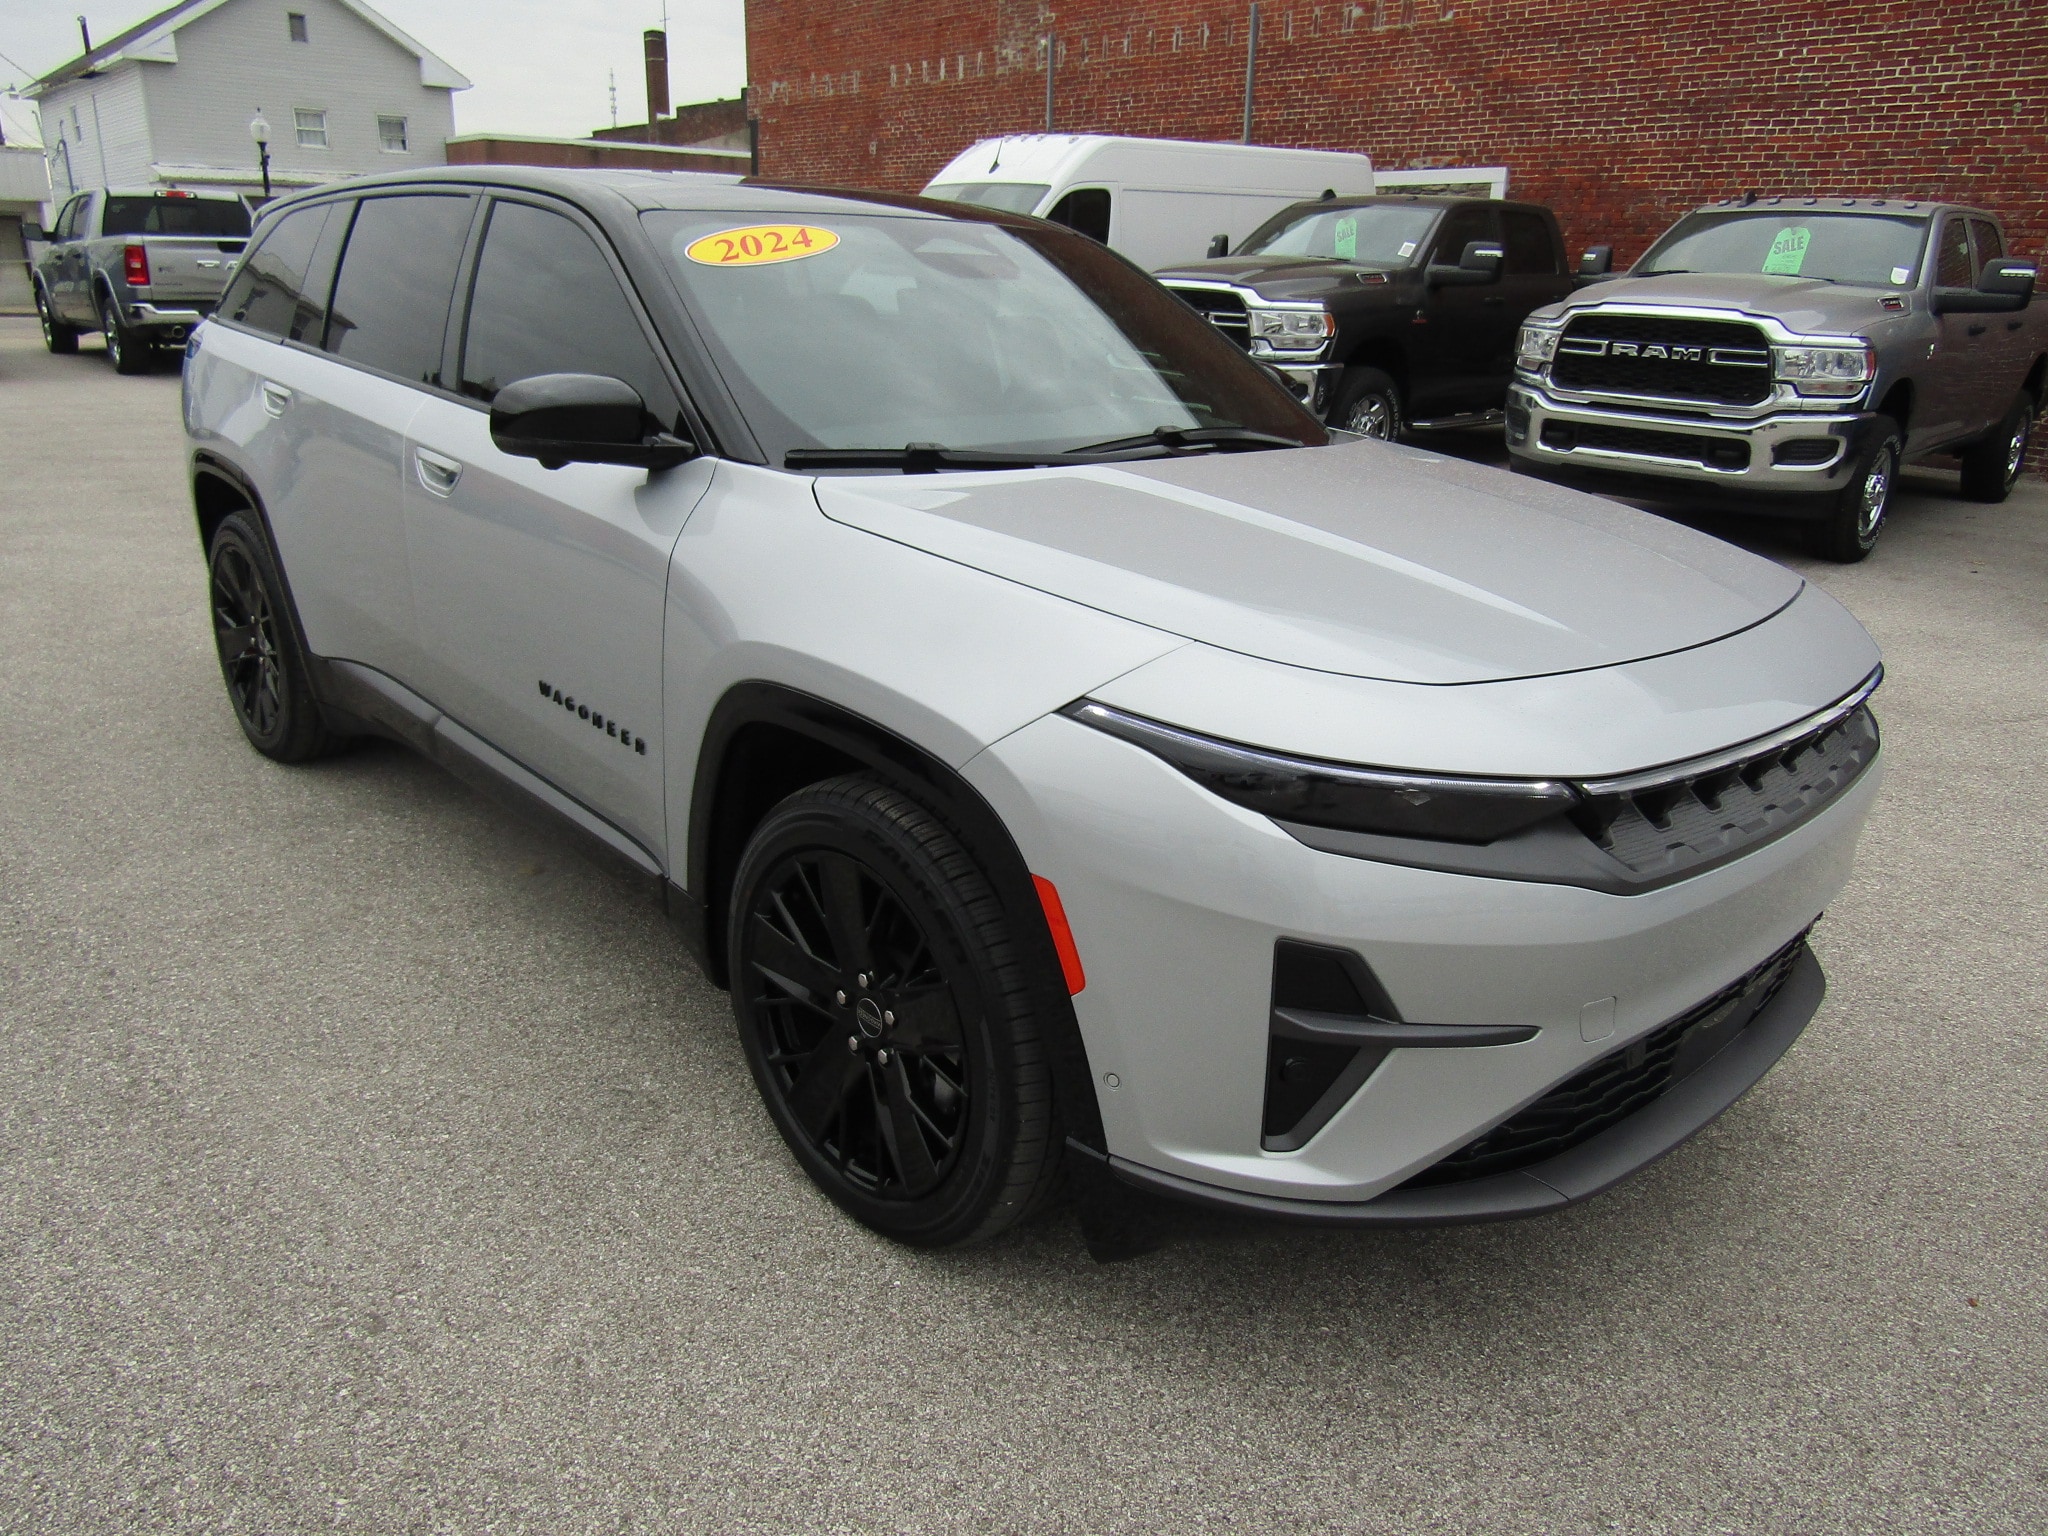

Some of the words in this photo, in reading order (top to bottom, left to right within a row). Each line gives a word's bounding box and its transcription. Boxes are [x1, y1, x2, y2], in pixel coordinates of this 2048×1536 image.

[714, 228, 813, 262] 2024
[1773, 236, 1805, 255] SALE
[1611, 342, 1702, 362] RAM
[538, 680, 647, 756] WAGONEER
